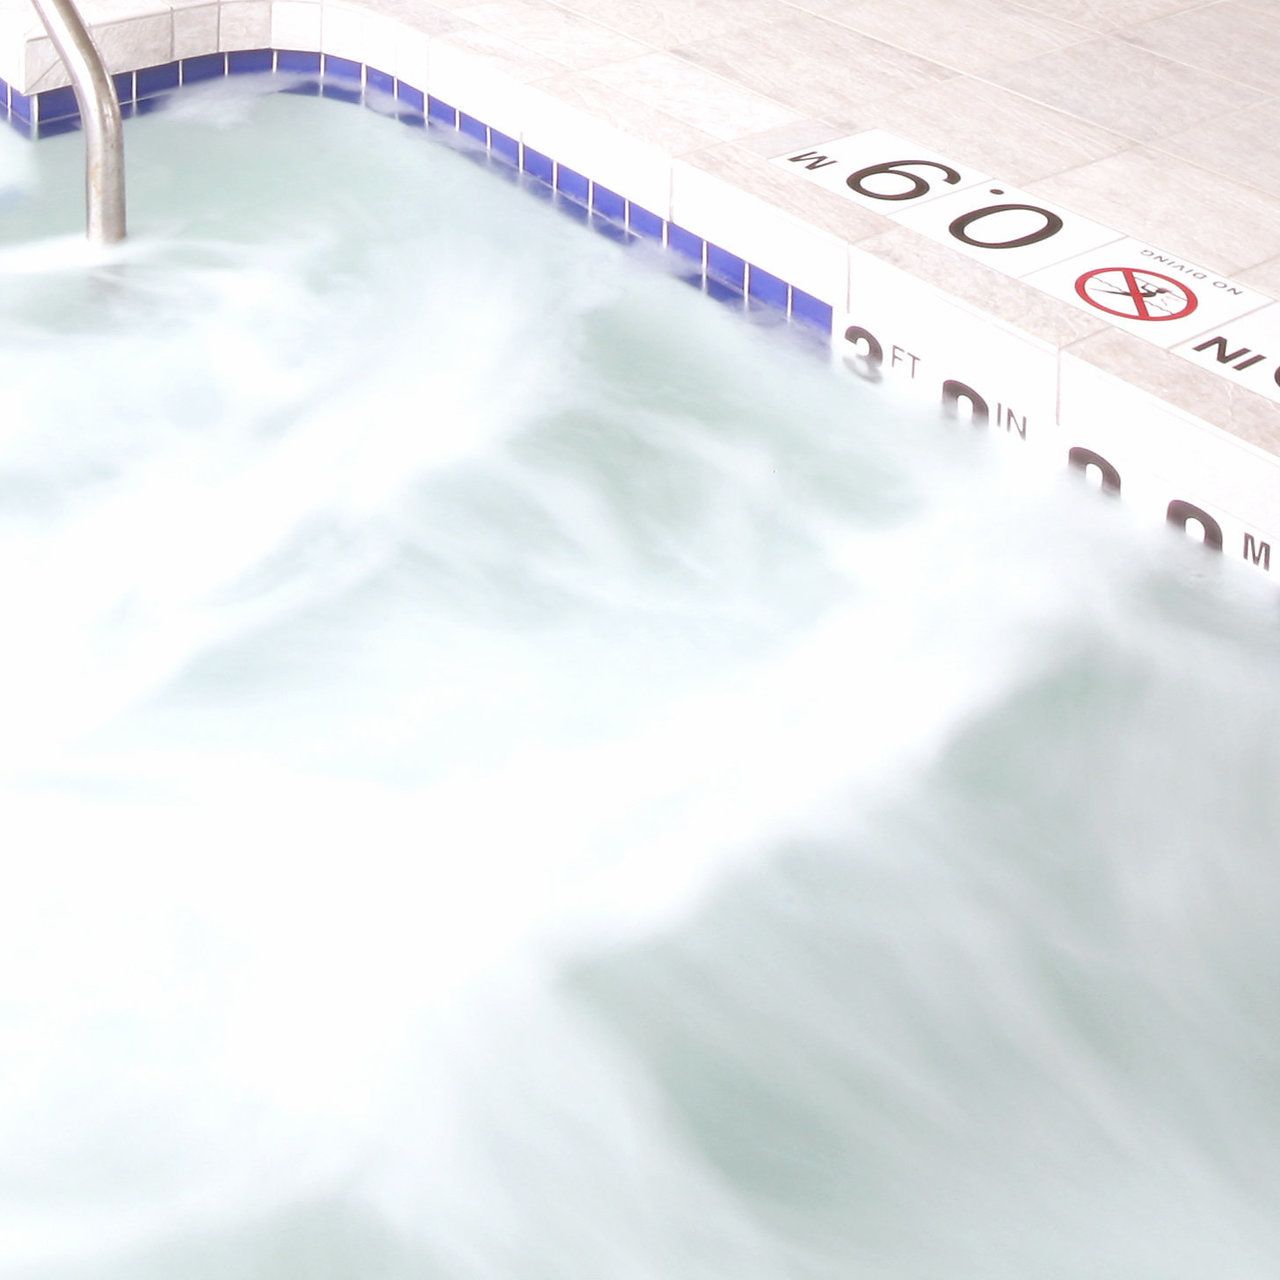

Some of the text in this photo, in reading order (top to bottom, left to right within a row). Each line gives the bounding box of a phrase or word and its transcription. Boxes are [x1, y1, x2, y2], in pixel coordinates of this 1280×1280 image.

[787, 141, 838, 170] M
[1140, 249, 1244, 296] NO DIVING
[1192, 335, 1267, 371] IN
[891, 344, 921, 379] FT
[997, 402, 1027, 441] IN
[1243, 532, 1271, 572] M
